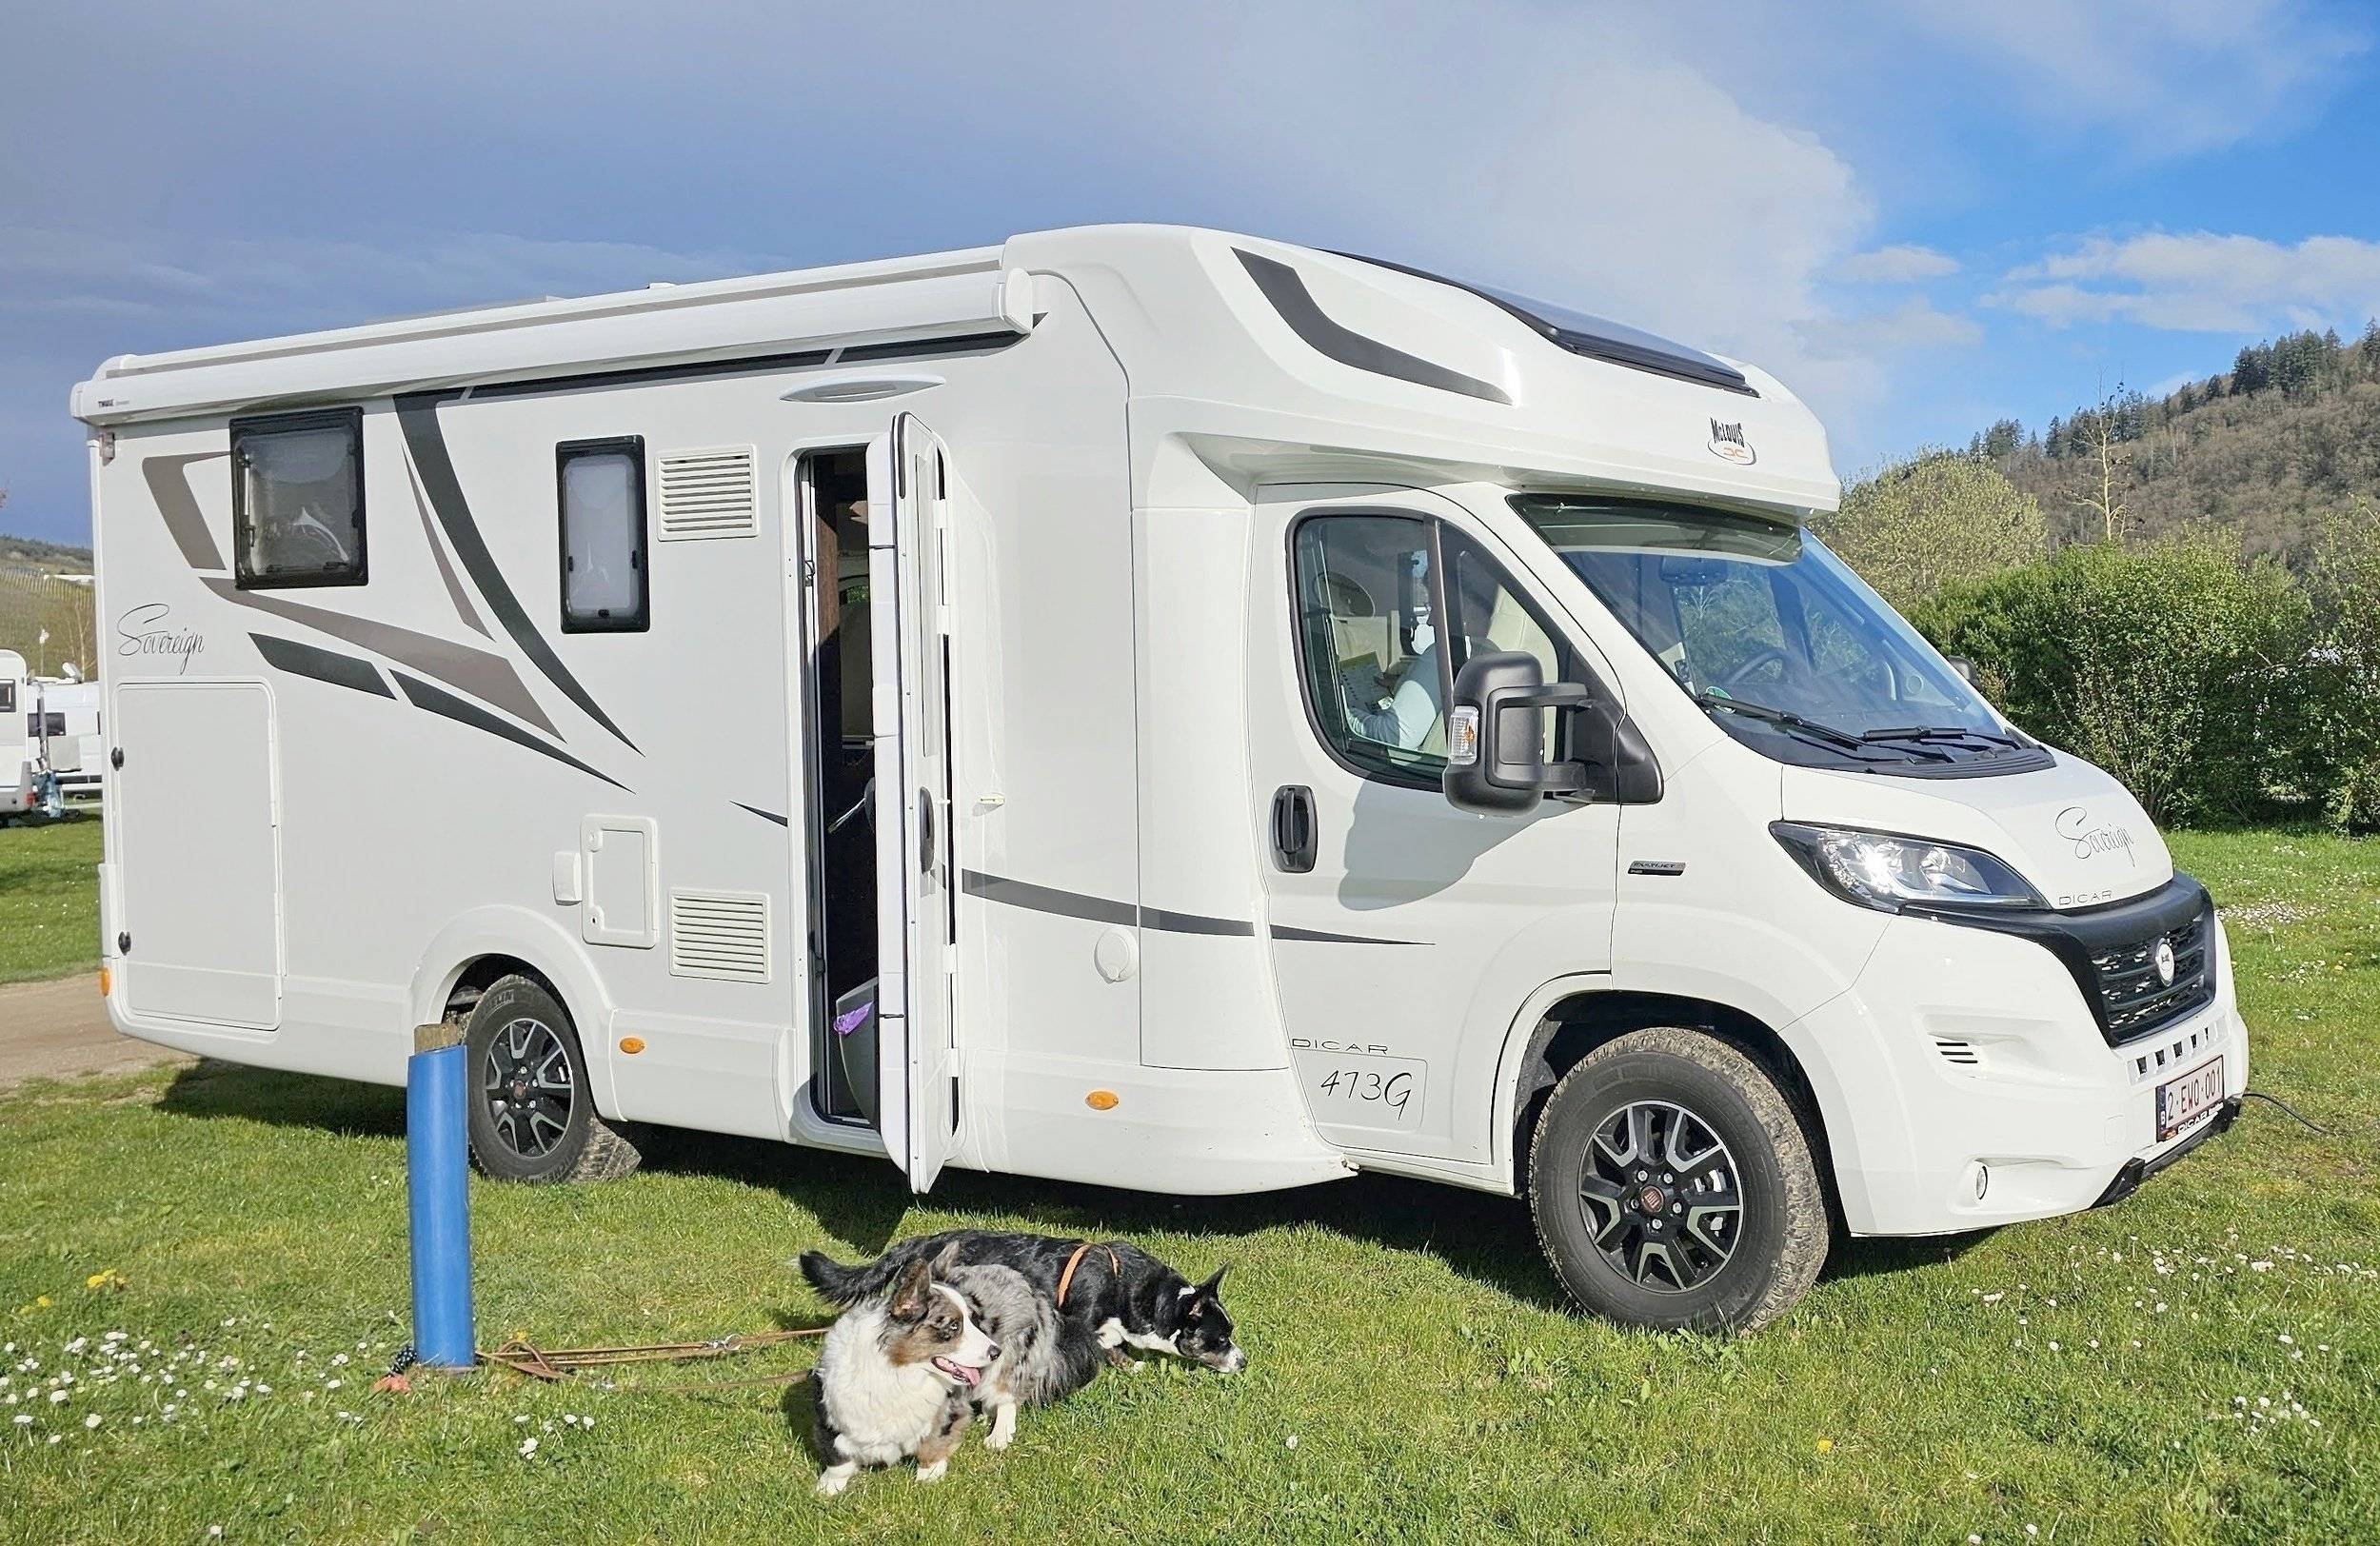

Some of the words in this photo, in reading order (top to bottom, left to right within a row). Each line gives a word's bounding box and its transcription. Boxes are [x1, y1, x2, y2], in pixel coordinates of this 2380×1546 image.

[117, 603, 205, 675] Sovereign
[2055, 806, 2135, 868] Sovereign
[2058, 890, 2112, 905] DICAR
[1292, 1039, 1389, 1055] DICAR
[1320, 1070, 1413, 1120] 473G
[2177, 1110, 2209, 1135] DICAR
